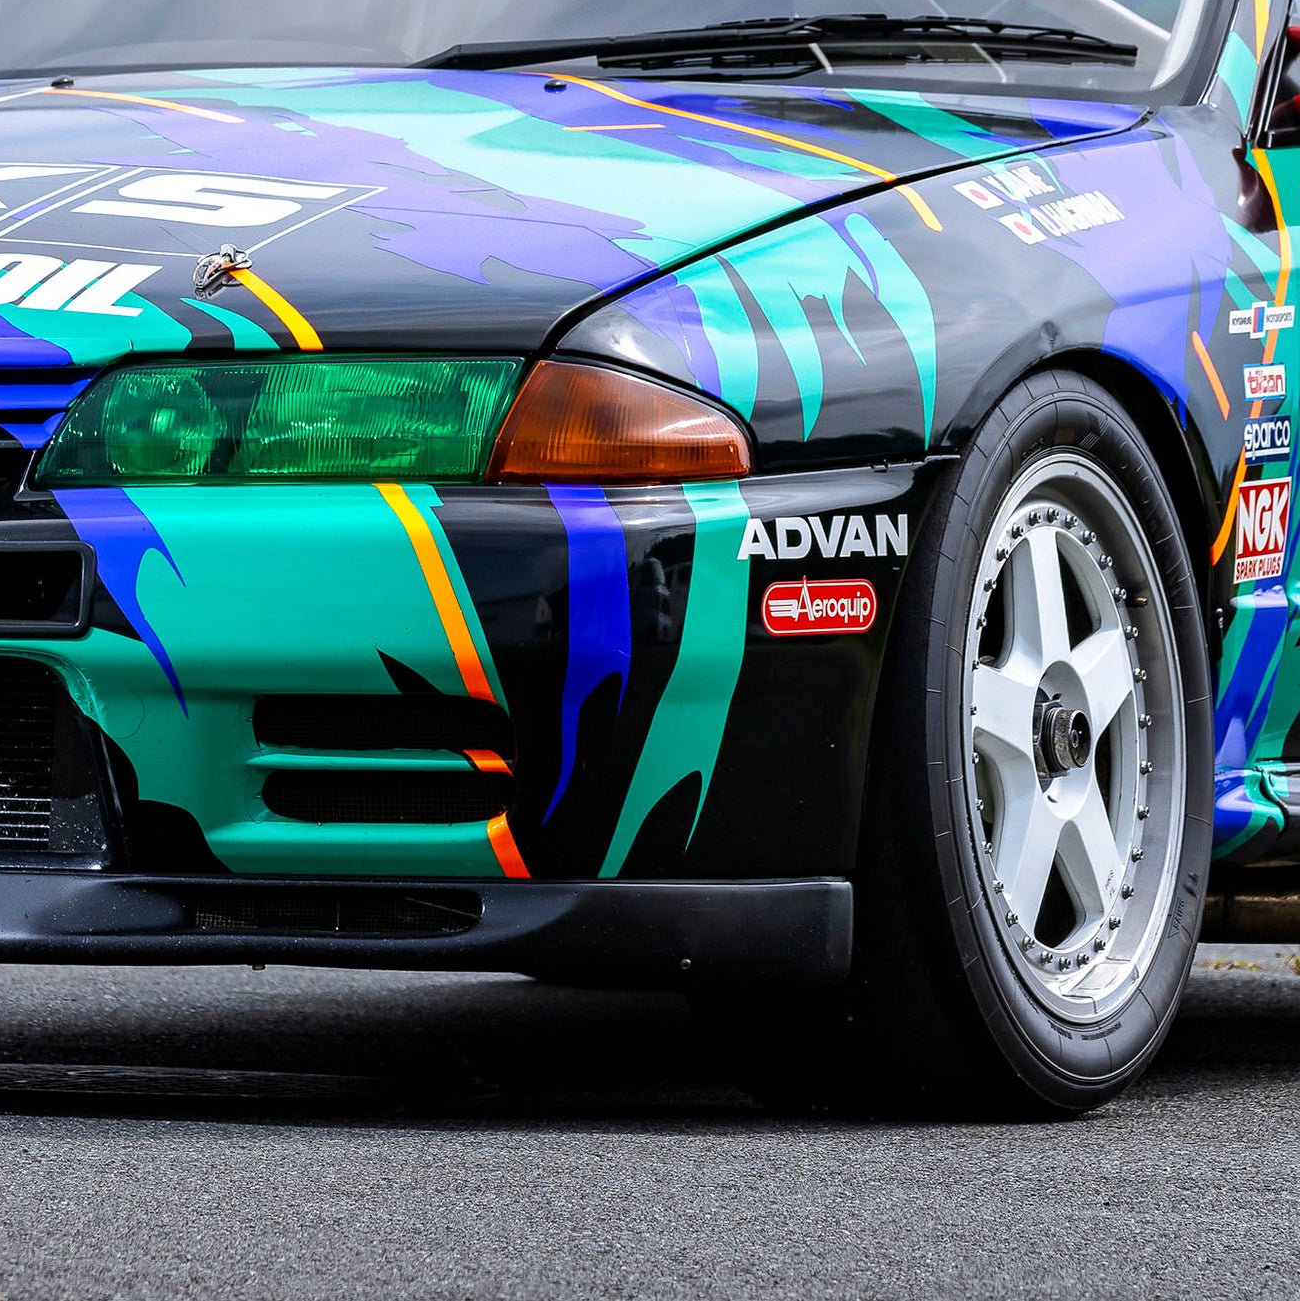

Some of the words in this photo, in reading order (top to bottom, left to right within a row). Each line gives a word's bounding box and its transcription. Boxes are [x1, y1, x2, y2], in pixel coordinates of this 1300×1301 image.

[1243, 419, 1291, 461] sparco
[737, 514, 908, 560] ADVAN
[1237, 484, 1289, 555] NGK
[1236, 559, 1258, 581] SPARK
[1258, 555, 1282, 577] PLUGS
[794, 575, 870, 624] Aeroquip
